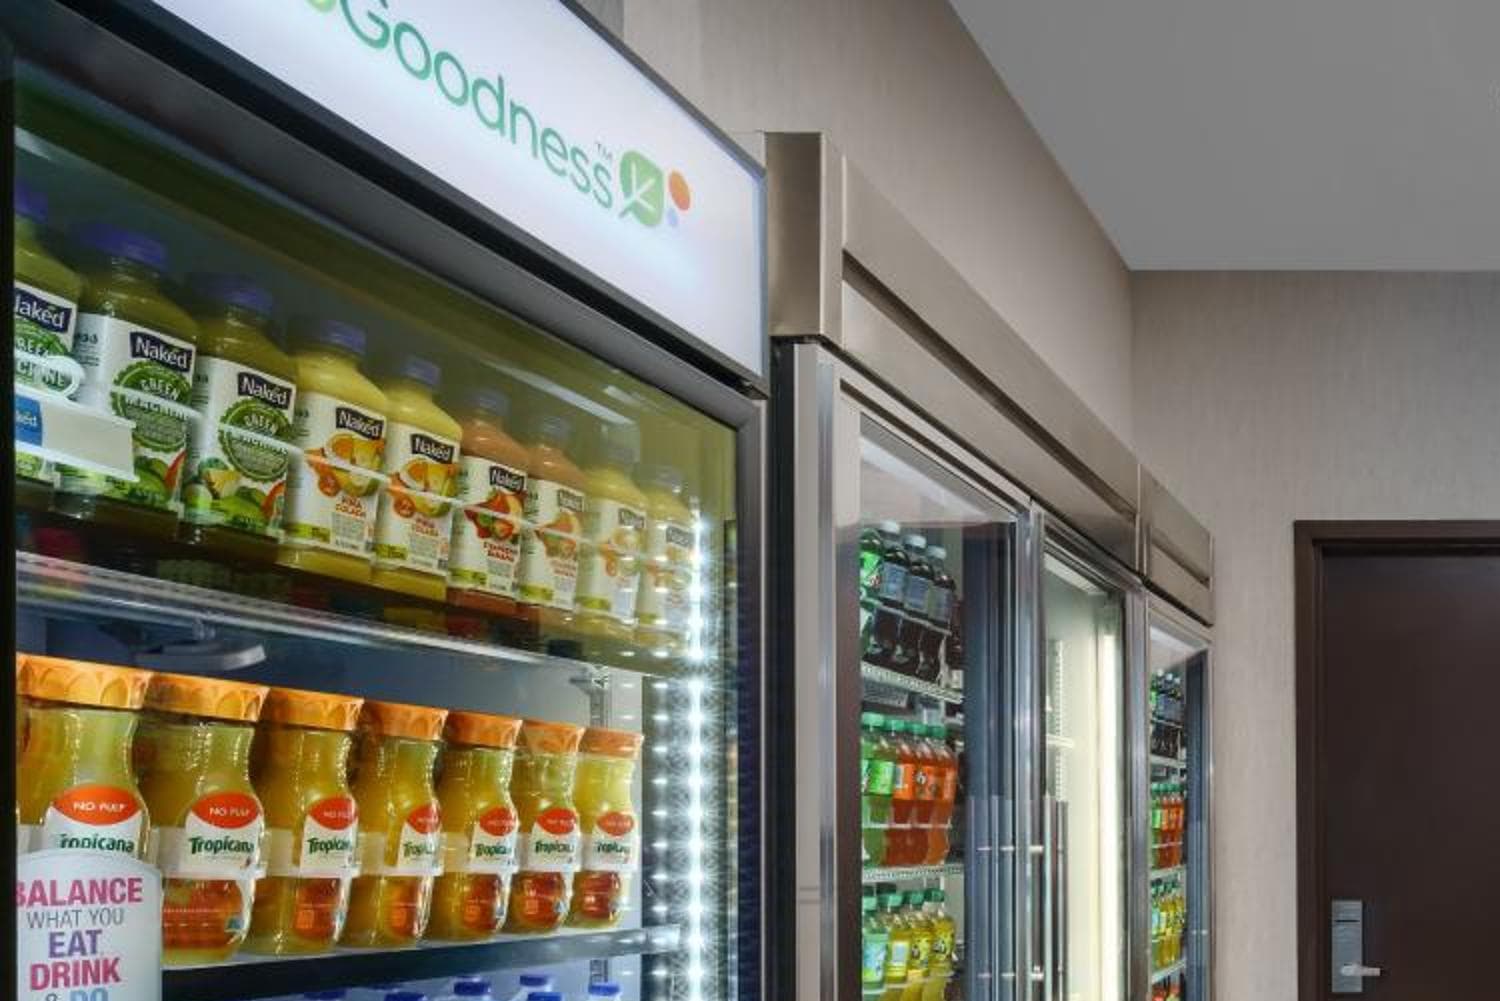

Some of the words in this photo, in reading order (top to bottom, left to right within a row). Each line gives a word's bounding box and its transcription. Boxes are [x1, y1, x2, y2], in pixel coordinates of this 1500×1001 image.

[15, 295, 65, 329] aked
[136, 336, 188, 370] Naked
[241, 376, 288, 406] Naked
[339, 410, 381, 438] Naked
[415, 435, 452, 461] Naked
[73, 801, 96, 812] NO
[189, 835, 255, 857] Tropicana
[17, 876, 144, 907] BALANCE
[26, 909, 86, 929] WHAT
[88, 909, 125, 926] YOU
[48, 929, 102, 958] EAT
[30, 957, 122, 991] DRINK
